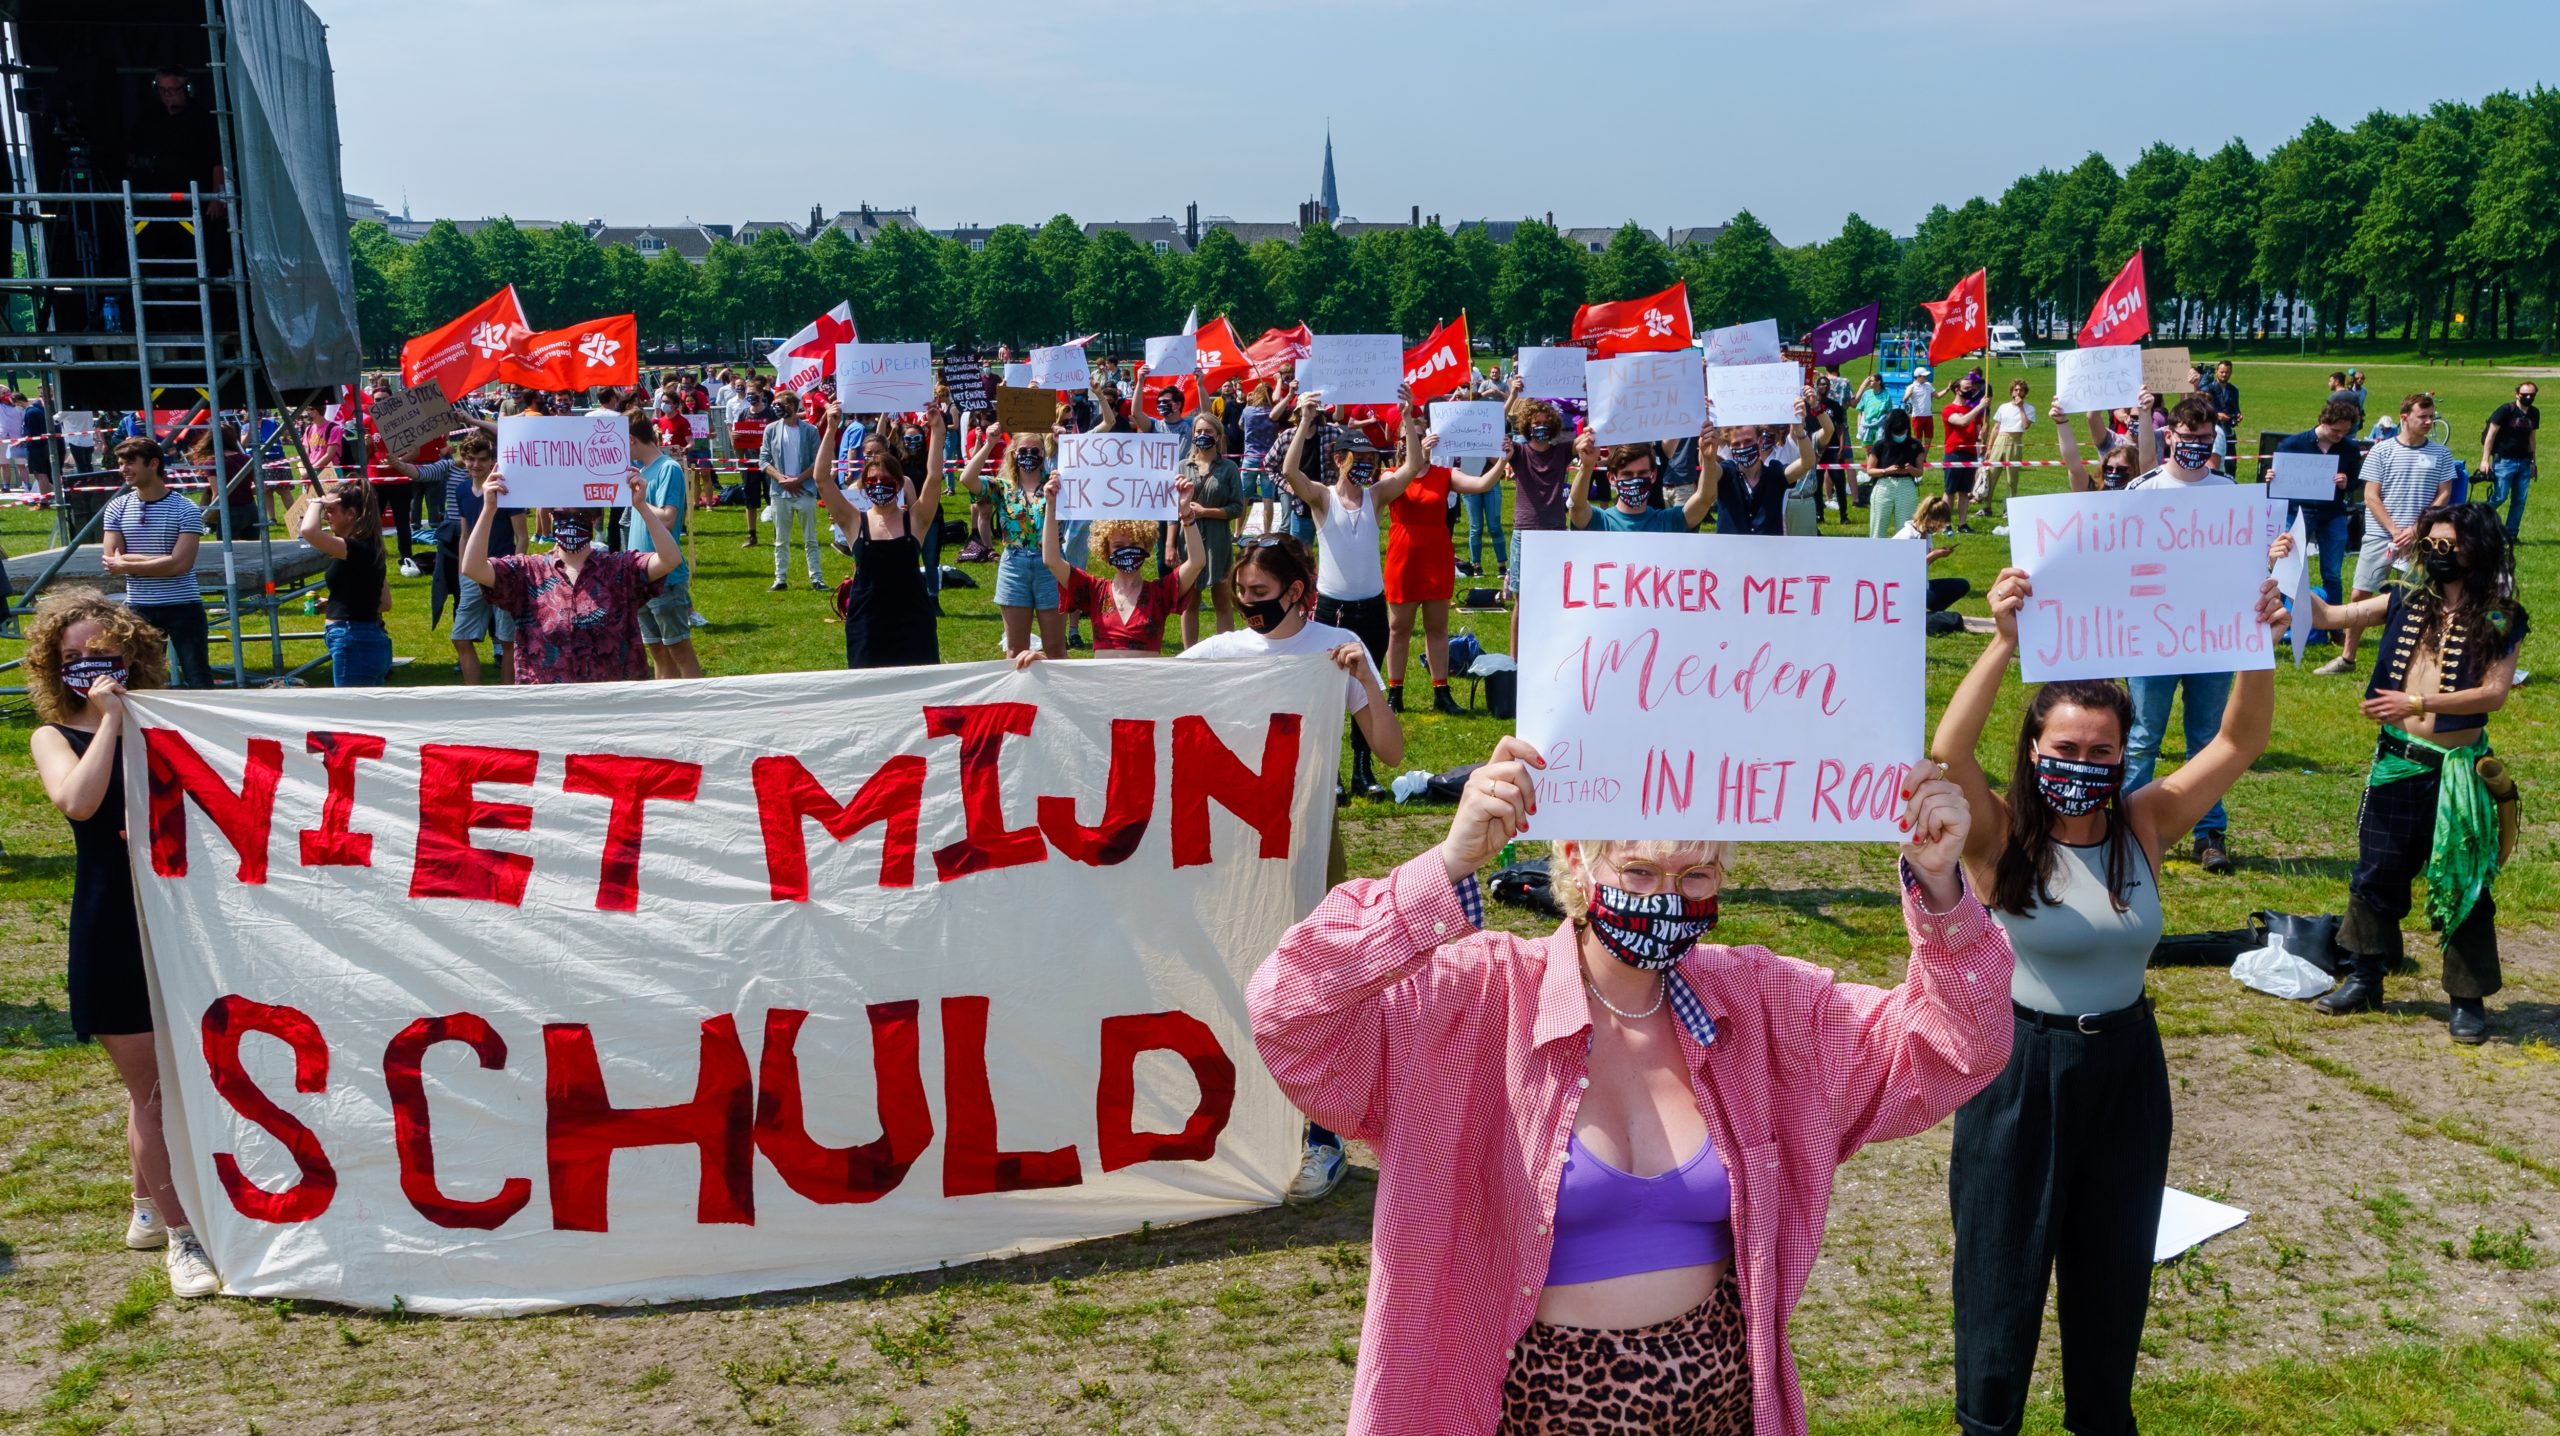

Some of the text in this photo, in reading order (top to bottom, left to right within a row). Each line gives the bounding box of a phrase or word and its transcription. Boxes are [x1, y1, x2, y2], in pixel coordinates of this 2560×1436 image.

[839, 357, 931, 377] GEDUPEERD
[1608, 357, 1695, 386] NIET
[959, 400, 988, 412] SCHULD
[1611, 386, 1679, 410] MIJN
[1605, 412, 1691, 434] SCHULD
[588, 446, 623, 468] SCHULD
[1140, 440, 1178, 471] NIET
[585, 486, 616, 500] ASVA
[1063, 476, 1177, 509] IK STAAK
[2035, 510, 2145, 557] Mijn
[2156, 505, 2254, 552] Schuld
[1563, 560, 1901, 625] LEKKER MET DE
[2153, 602, 2266, 658] Schuld
[1554, 628, 1847, 716] Meiden
[1549, 738, 1583, 771] 21
[1641, 745, 1695, 820] IN
[1716, 752, 1797, 825] HET
[140, 702, 1302, 913] NIET MIJN
[1602, 885, 1683, 916] STAAK! IK
[201, 994, 1236, 1232] SCHULD
